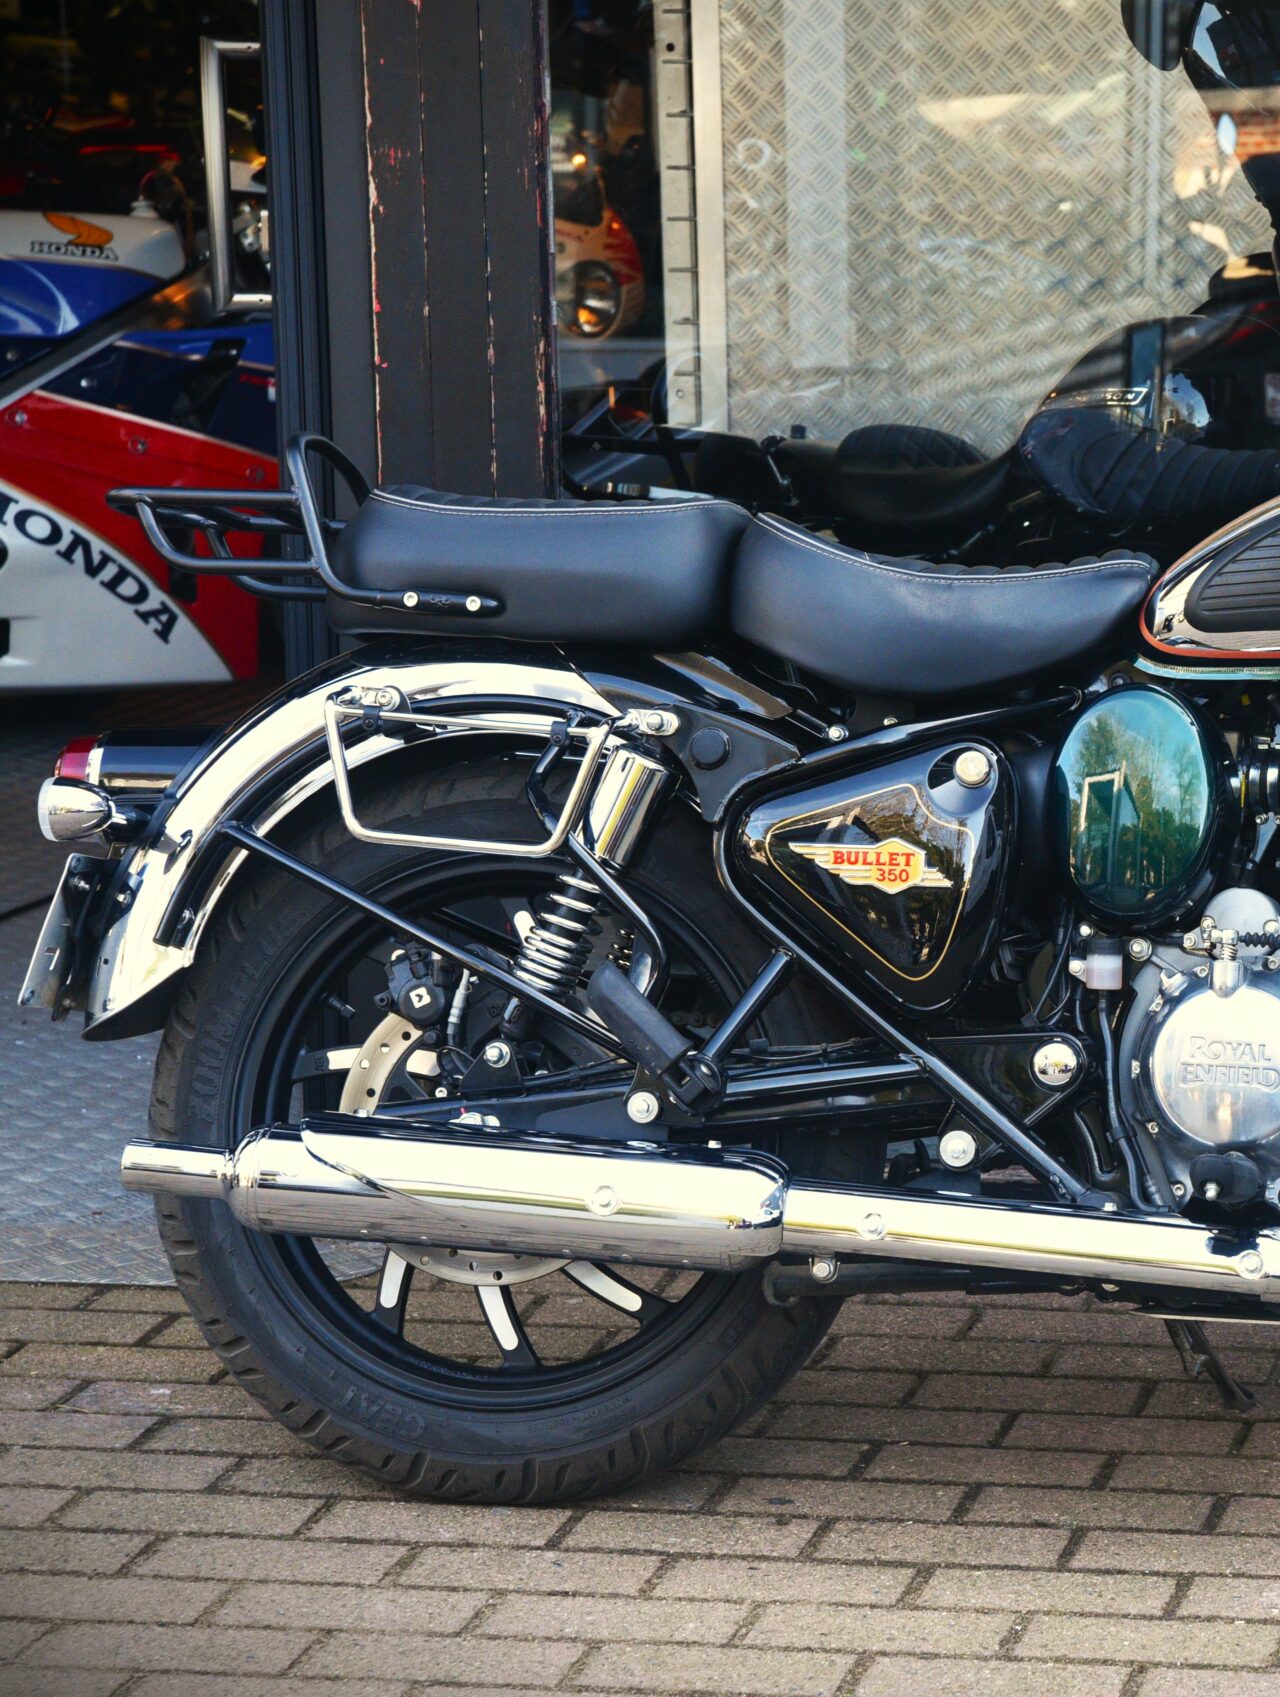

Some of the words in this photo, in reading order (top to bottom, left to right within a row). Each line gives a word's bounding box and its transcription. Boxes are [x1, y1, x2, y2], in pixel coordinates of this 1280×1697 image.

[30, 240, 119, 262] HONDA
[832, 850, 916, 867] BULLET
[875, 867, 910, 883] 350
[1189, 1035, 1272, 1062] ROYAL
